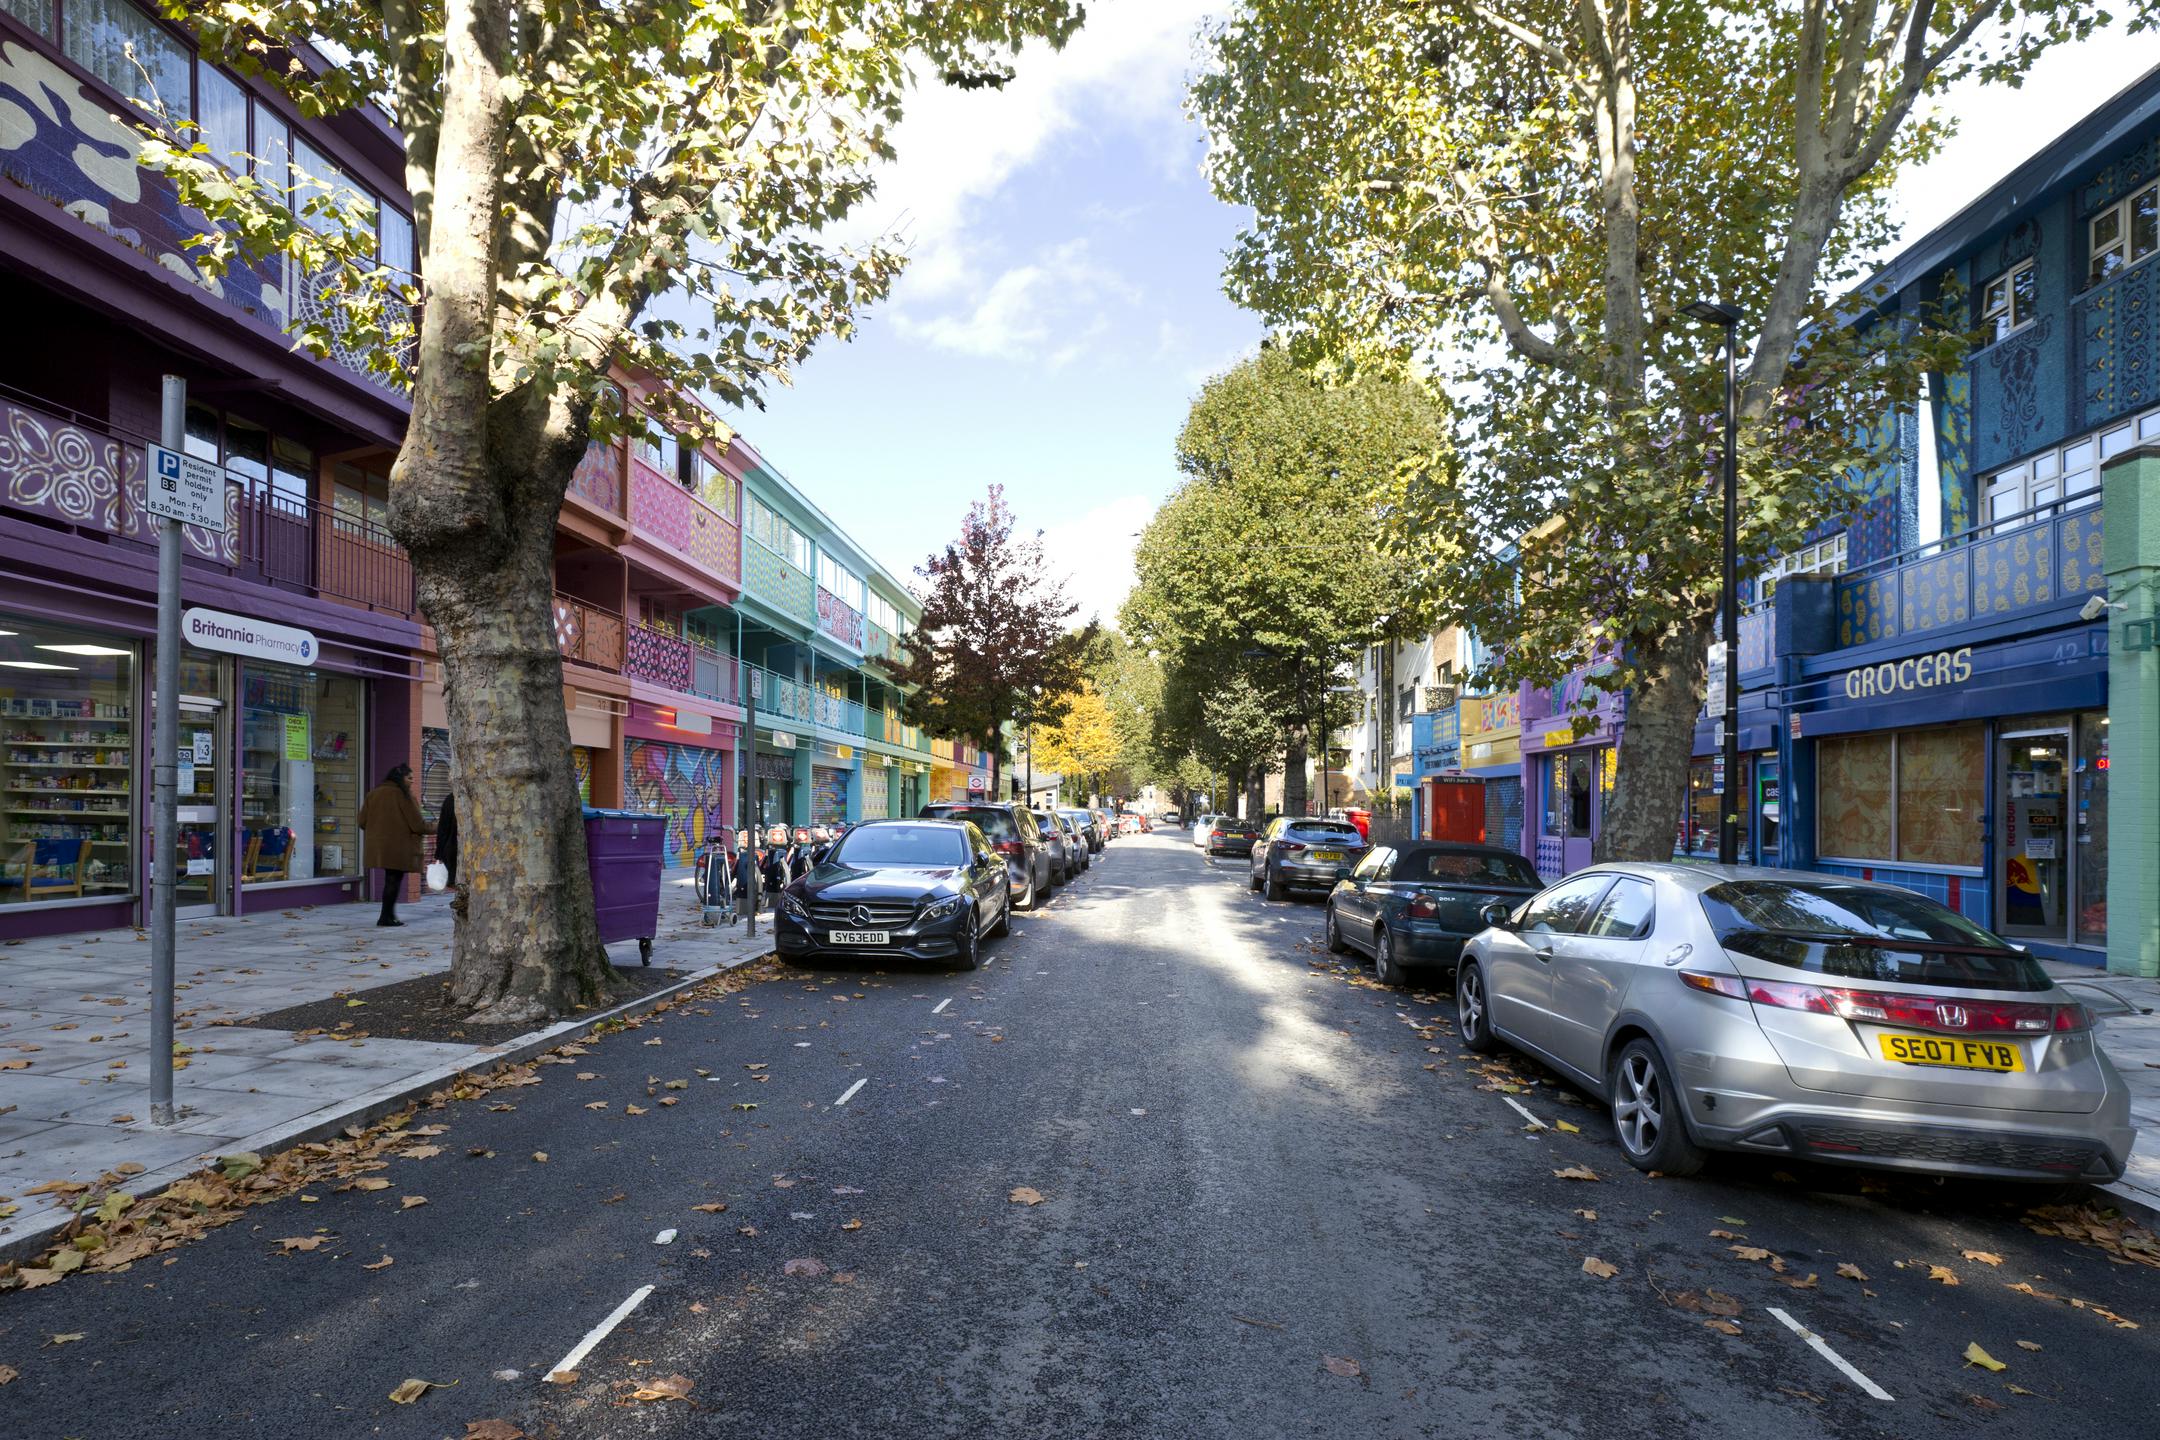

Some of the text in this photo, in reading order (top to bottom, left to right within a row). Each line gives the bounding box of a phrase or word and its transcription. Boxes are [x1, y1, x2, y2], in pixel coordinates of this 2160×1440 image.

[163, 453, 177, 474] P
[182, 459, 217, 478] Resident
[162, 479, 176, 491] B3
[184, 478, 214, 494] holders
[186, 471, 212, 485] permit
[168, 495, 187, 508] Mon
[192, 502, 203, 513] Fri
[190, 490, 207, 502] only
[150, 501, 171, 513] 8.30
[172, 508, 185, 518] am
[190, 512, 210, 524] 5.30
[210, 520, 223, 529] pm
[192, 618, 301, 655] Britannia Pharmacy
[1845, 647, 1973, 699] GROCERS
[1890, 1037, 1956, 1063] SE07
[1964, 1043, 2014, 1068] FVB
